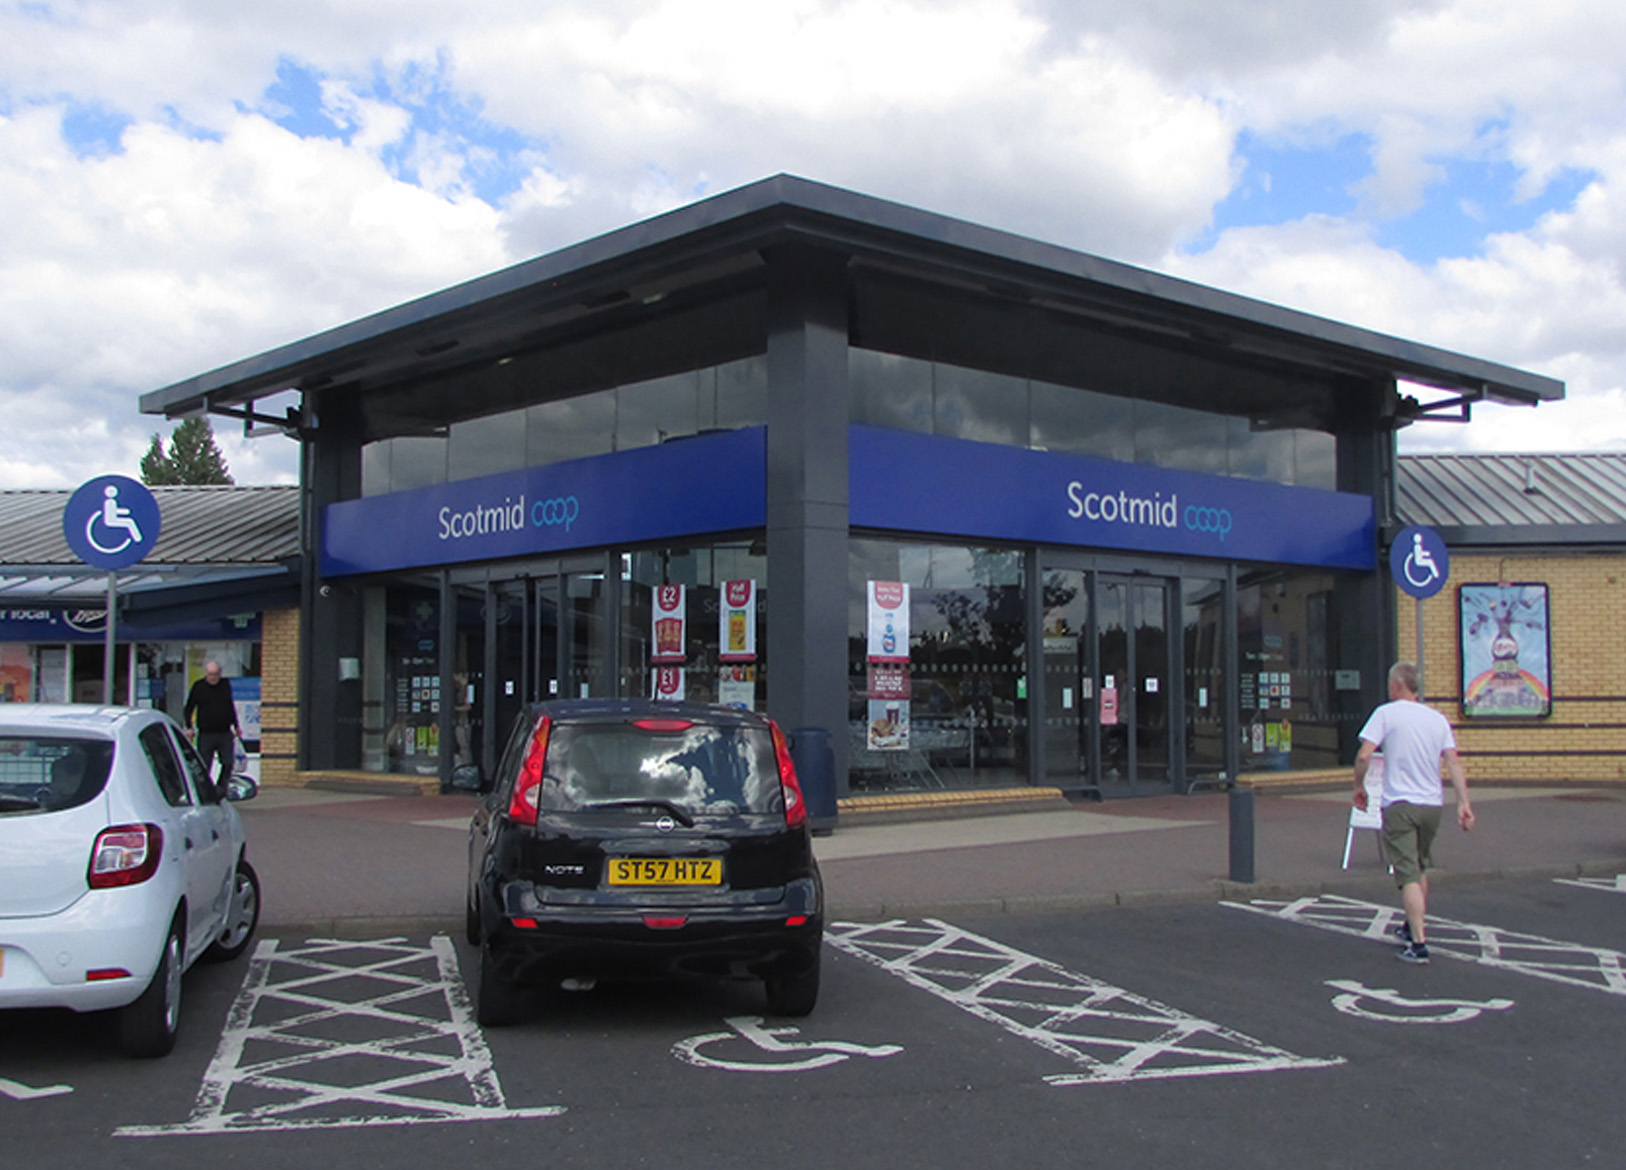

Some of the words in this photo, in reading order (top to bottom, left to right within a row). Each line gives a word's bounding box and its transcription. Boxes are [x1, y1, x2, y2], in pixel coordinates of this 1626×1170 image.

[438, 494, 526, 540] Scotmid
[532, 495, 580, 533] coop
[1067, 481, 1178, 529] Scotmid
[1183, 505, 1233, 542] coop
[662, 587, 677, 605] £2
[544, 864, 586, 875] NOTE
[618, 860, 671, 881] ST57
[676, 861, 713, 881] HTZ
